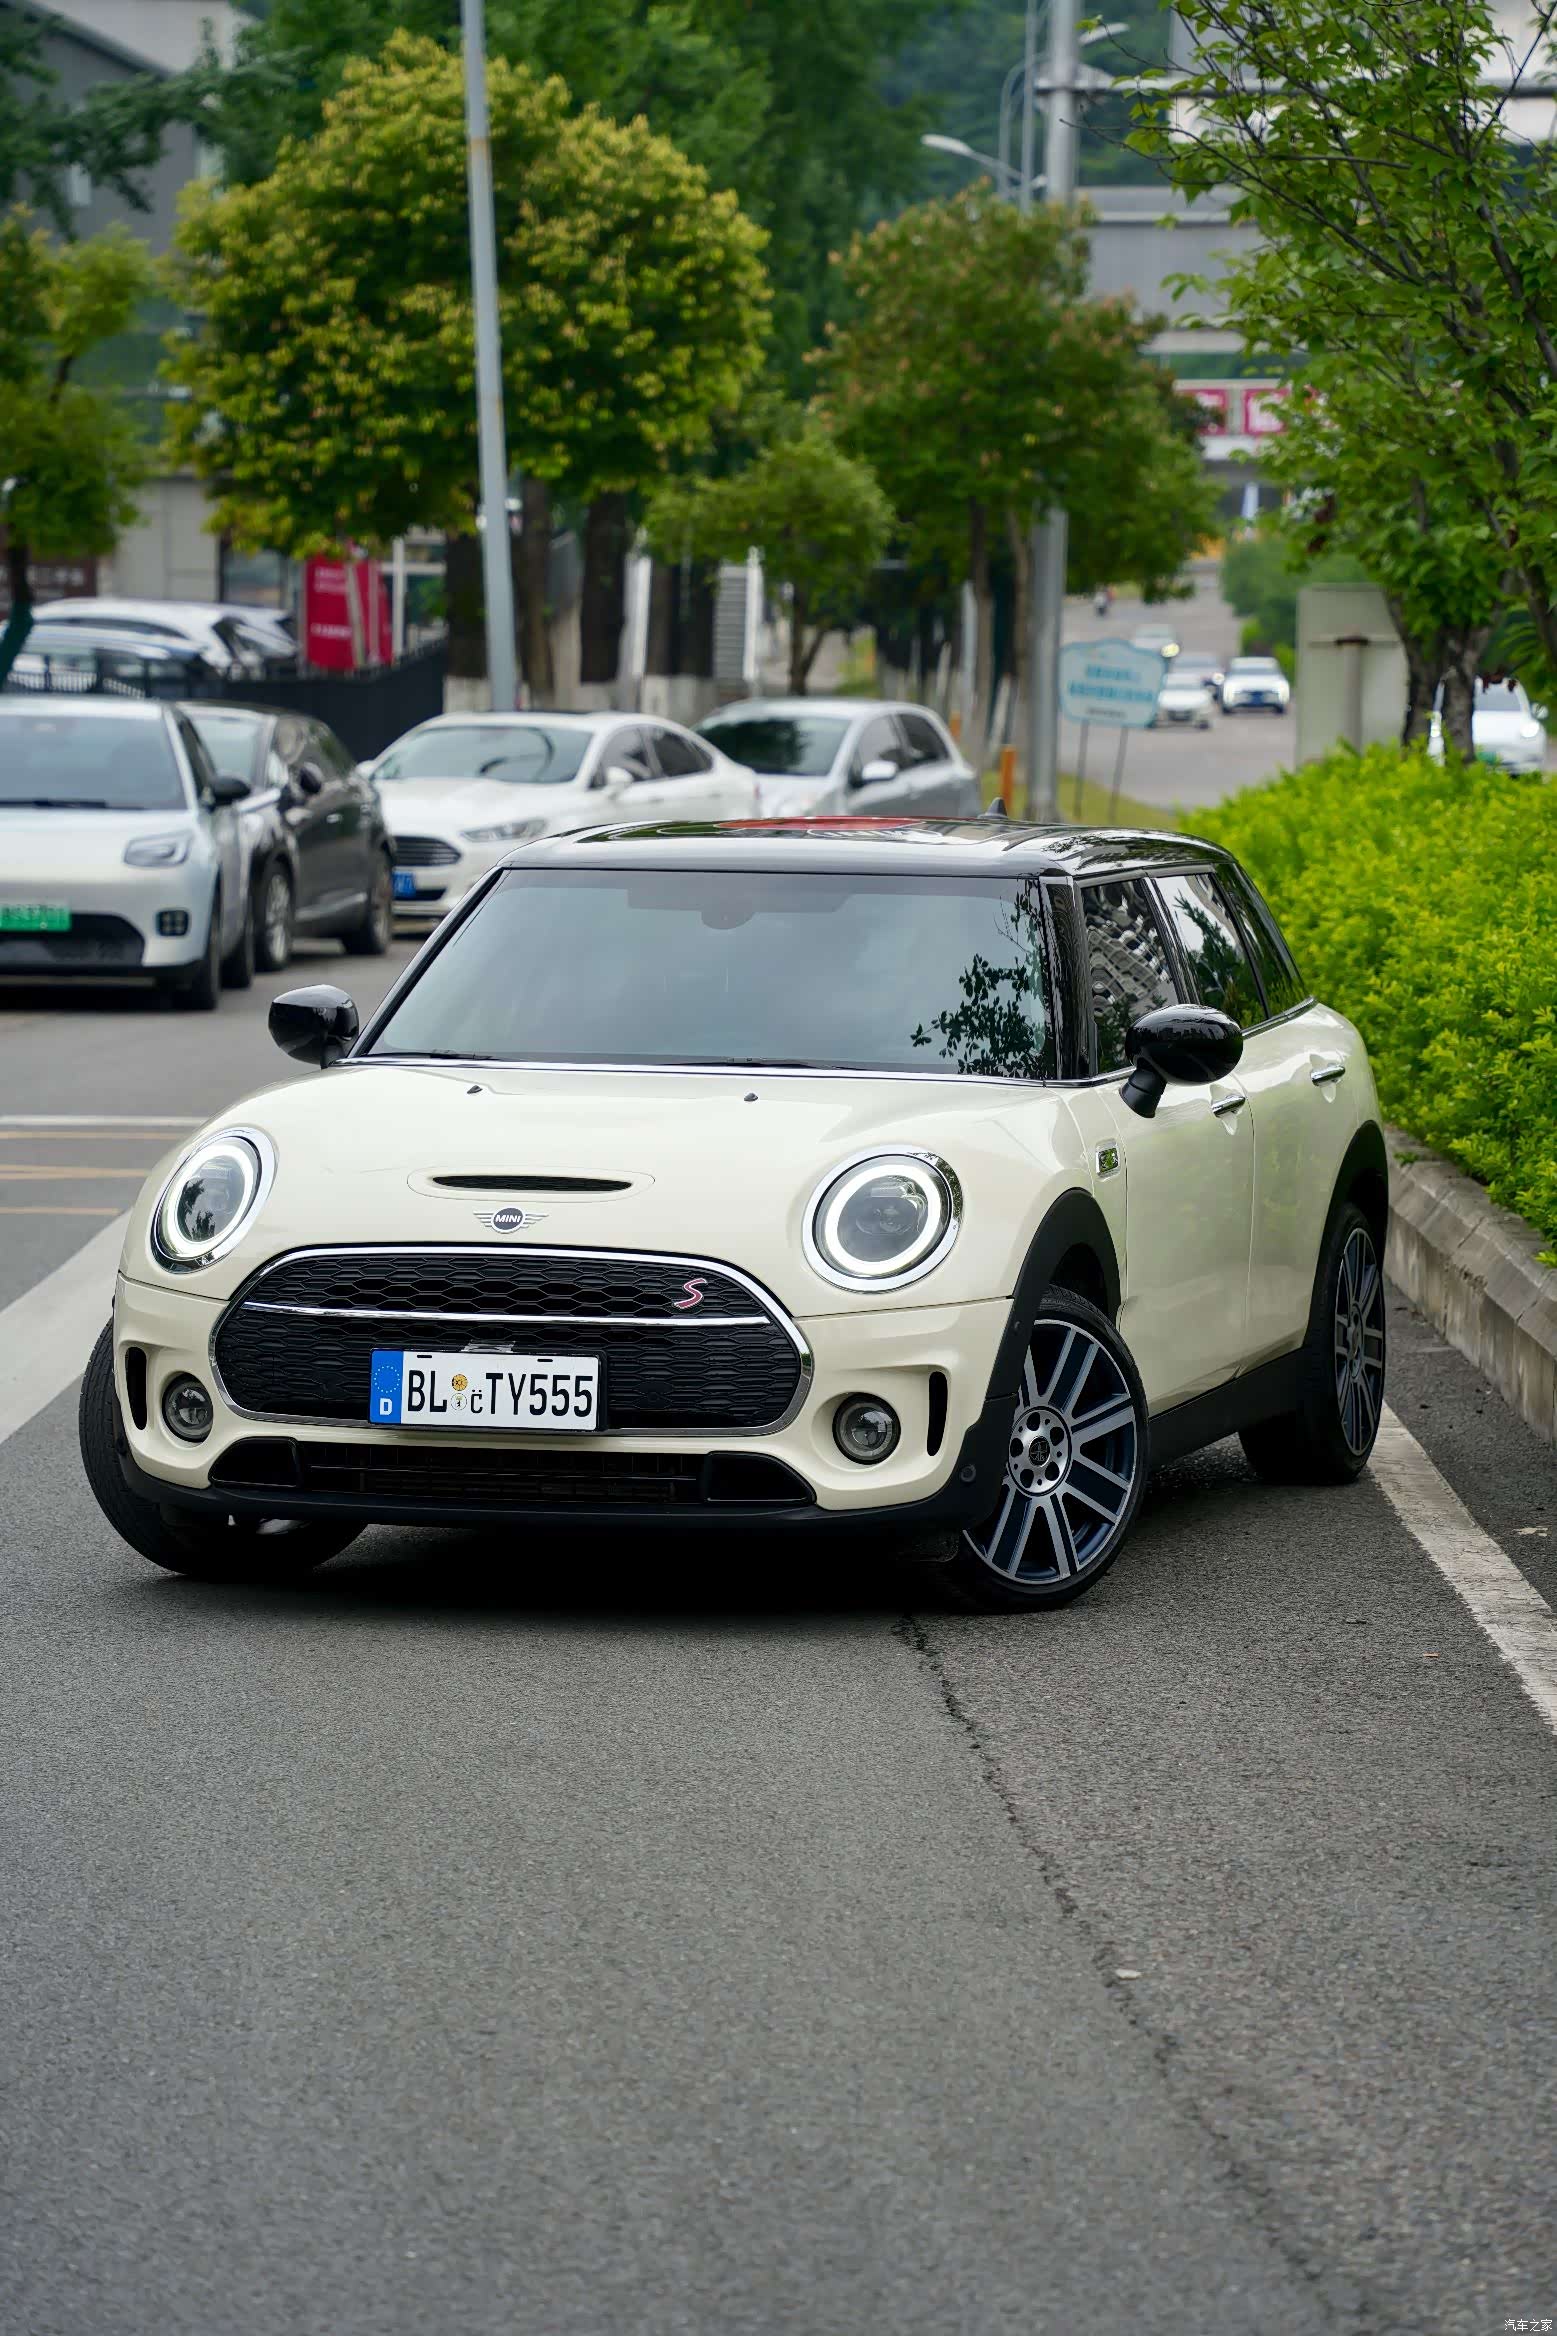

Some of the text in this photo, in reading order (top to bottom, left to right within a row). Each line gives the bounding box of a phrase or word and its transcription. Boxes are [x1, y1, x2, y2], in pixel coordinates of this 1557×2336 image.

[495, 1214, 522, 1223] MINI
[673, 1277, 708, 1309] S
[379, 1397, 393, 1416] D
